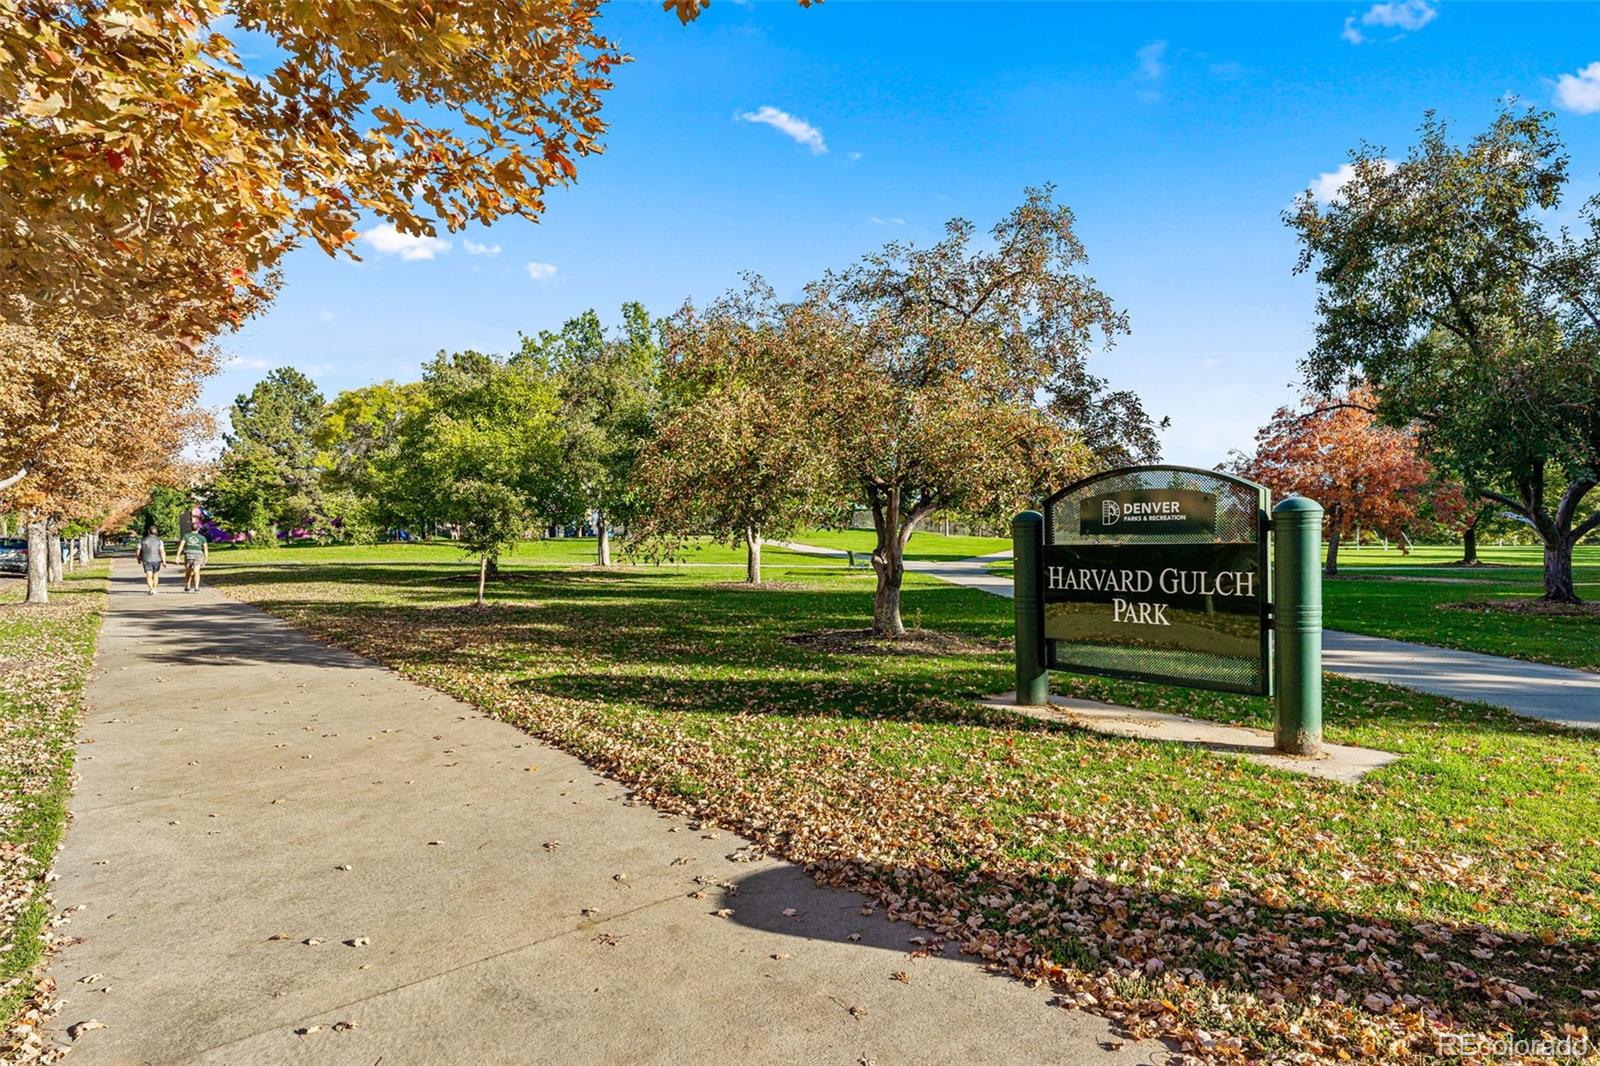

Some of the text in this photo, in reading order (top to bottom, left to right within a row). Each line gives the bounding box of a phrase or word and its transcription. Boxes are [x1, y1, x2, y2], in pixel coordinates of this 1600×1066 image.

[1123, 501, 1180, 514] DENVER
[1048, 566, 1256, 597] HARVARD GULCH
[1112, 598, 1171, 626] PARK
